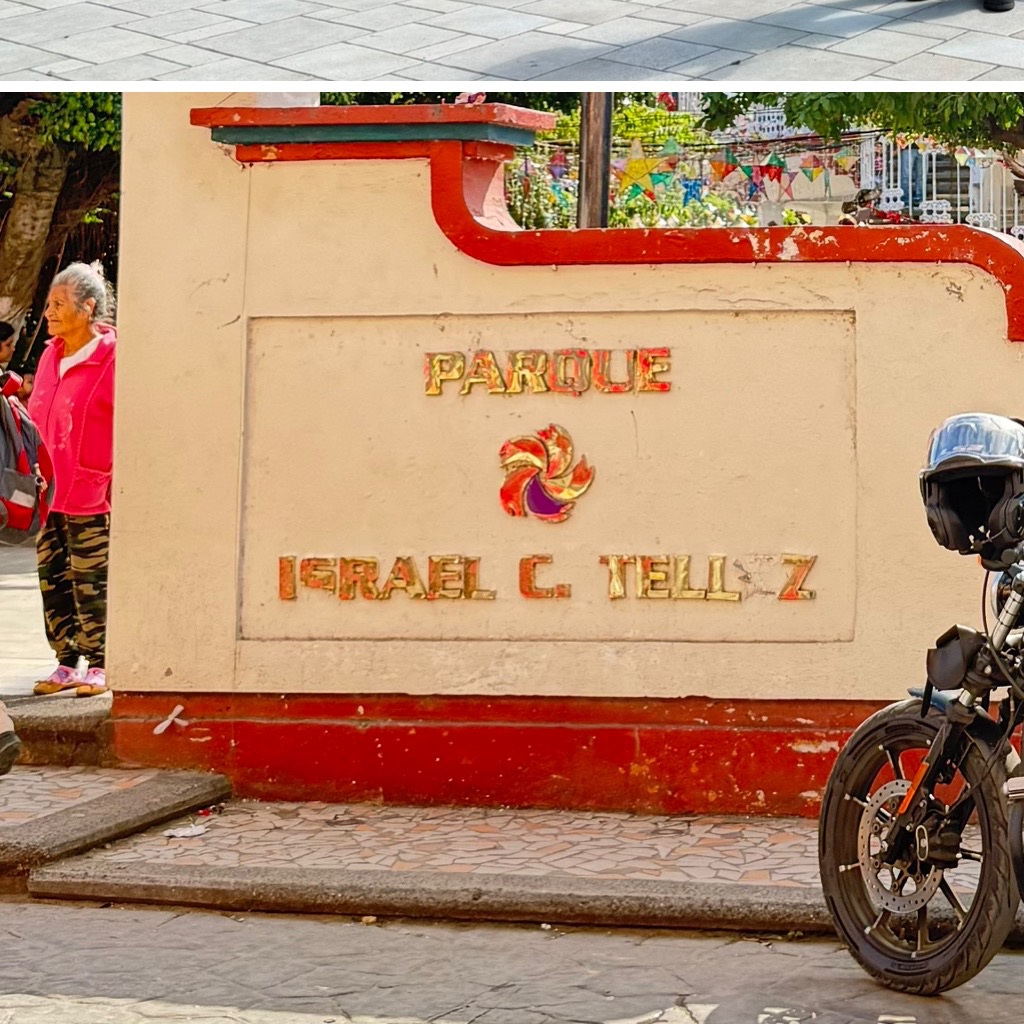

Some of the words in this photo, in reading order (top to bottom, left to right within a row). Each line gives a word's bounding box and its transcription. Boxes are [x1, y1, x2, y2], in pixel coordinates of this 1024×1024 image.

[424, 346, 672, 397] PARQUE
[278, 555, 498, 602] ISRAEL
[519, 554, 573, 601] C.
[599, 553, 819, 603] TELLZ
